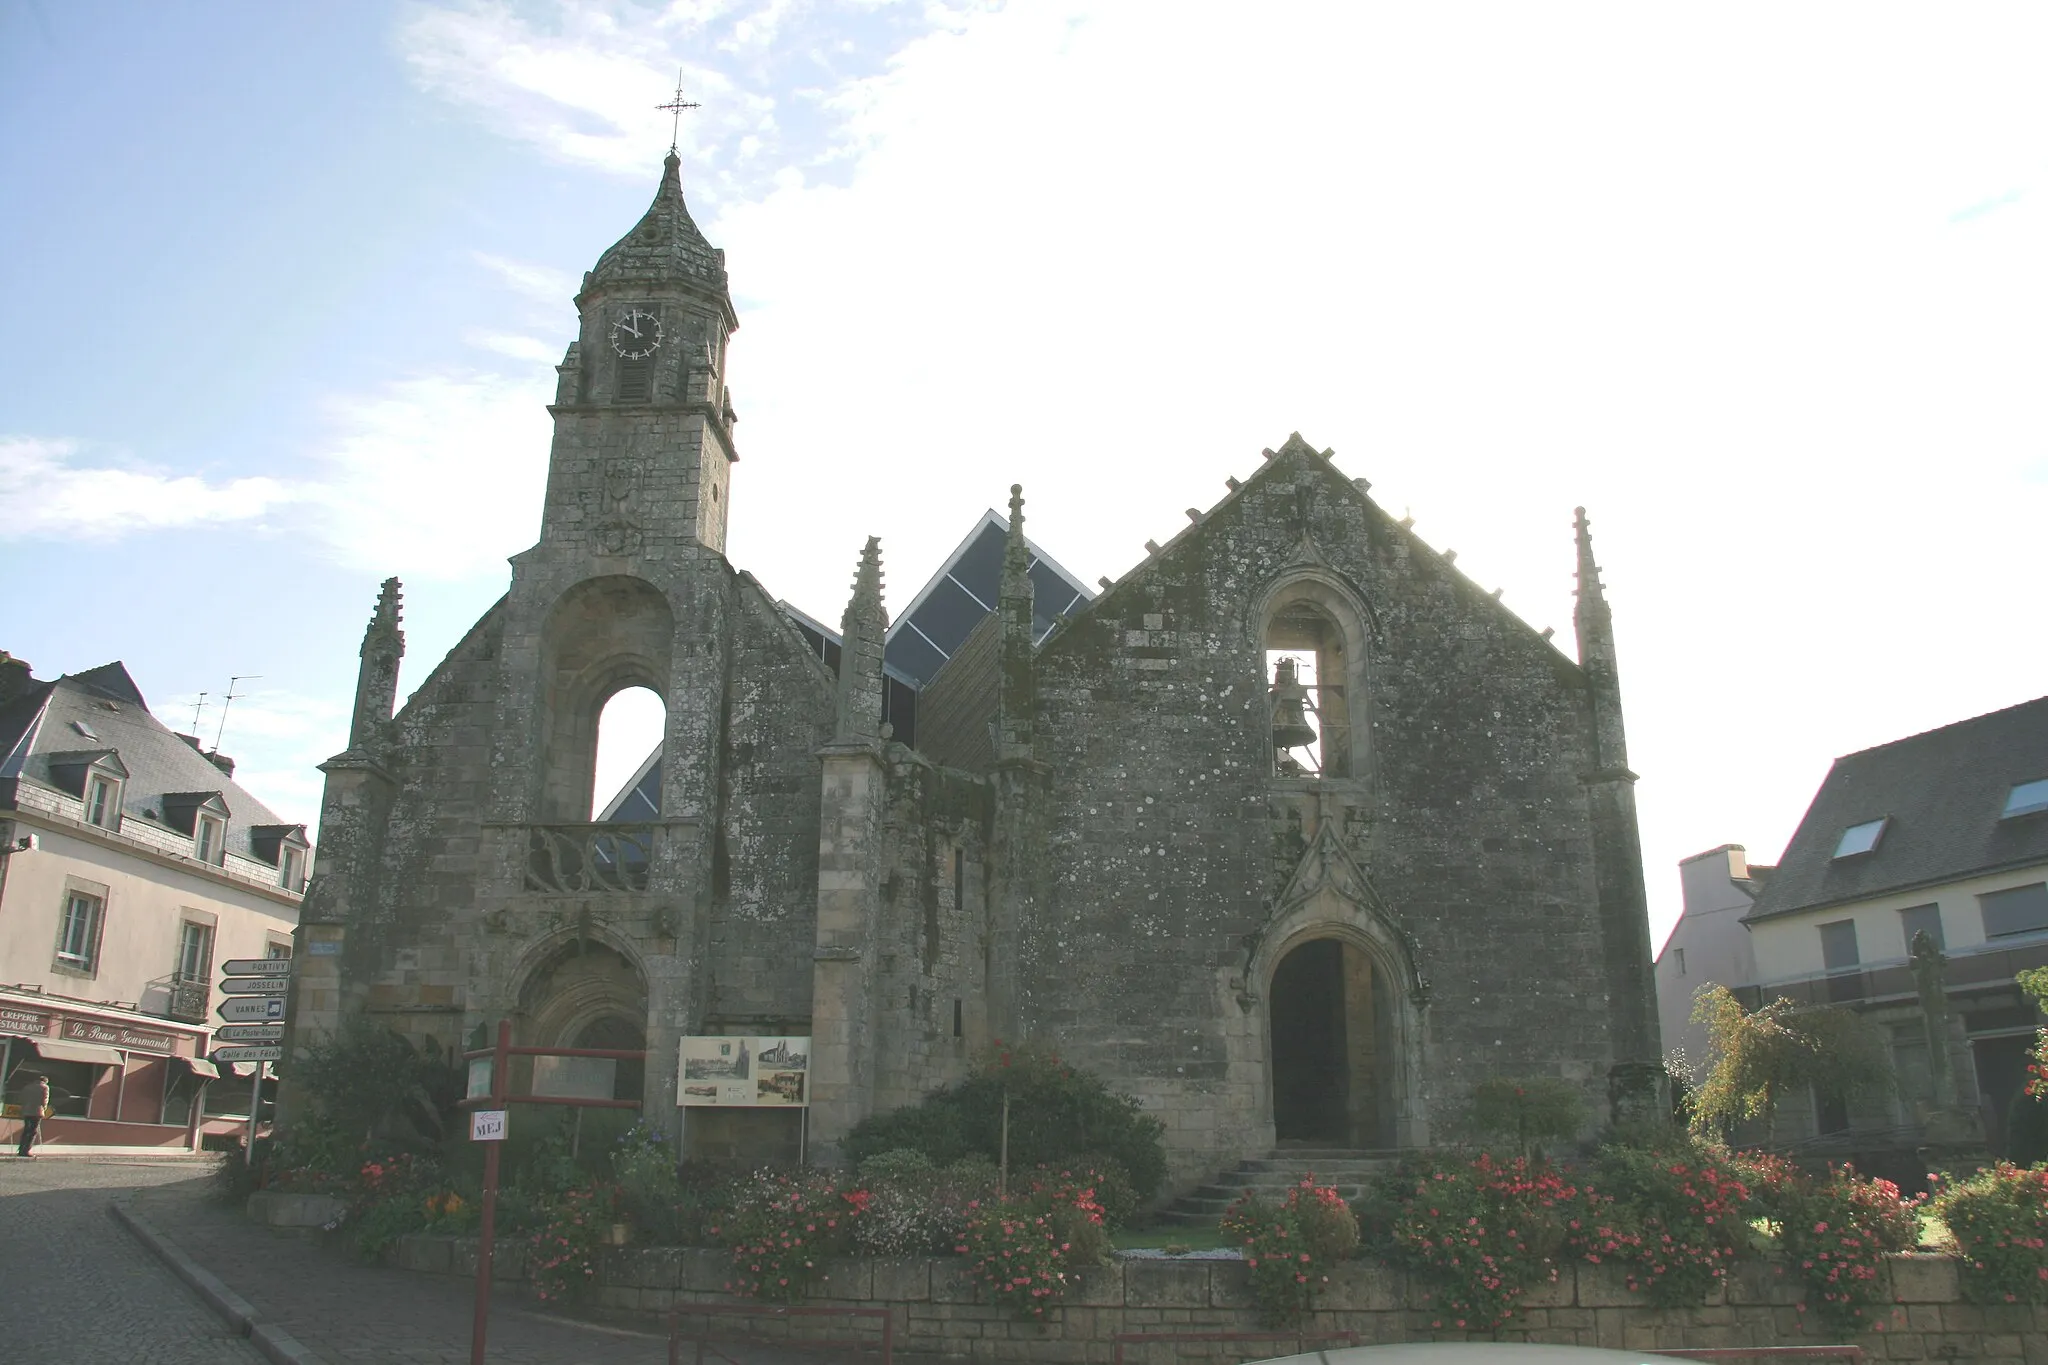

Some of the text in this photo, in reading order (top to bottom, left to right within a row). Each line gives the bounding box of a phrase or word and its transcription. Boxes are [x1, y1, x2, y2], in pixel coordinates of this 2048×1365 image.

[252, 963, 286, 971] PONTIVY
[247, 981, 284, 989] JOSSELIN
[235, 1005, 266, 1013] VANNES
[0, 1020, 45, 1032] STAURANT
[70, 1022, 170, 1049] La Pause Gourmande
[232, 1028, 280, 1037] La Poste-Mairie
[222, 1050, 240, 1058] Salle
[244, 1049, 256, 1058] des
[476, 1121, 502, 1136] MEJ
